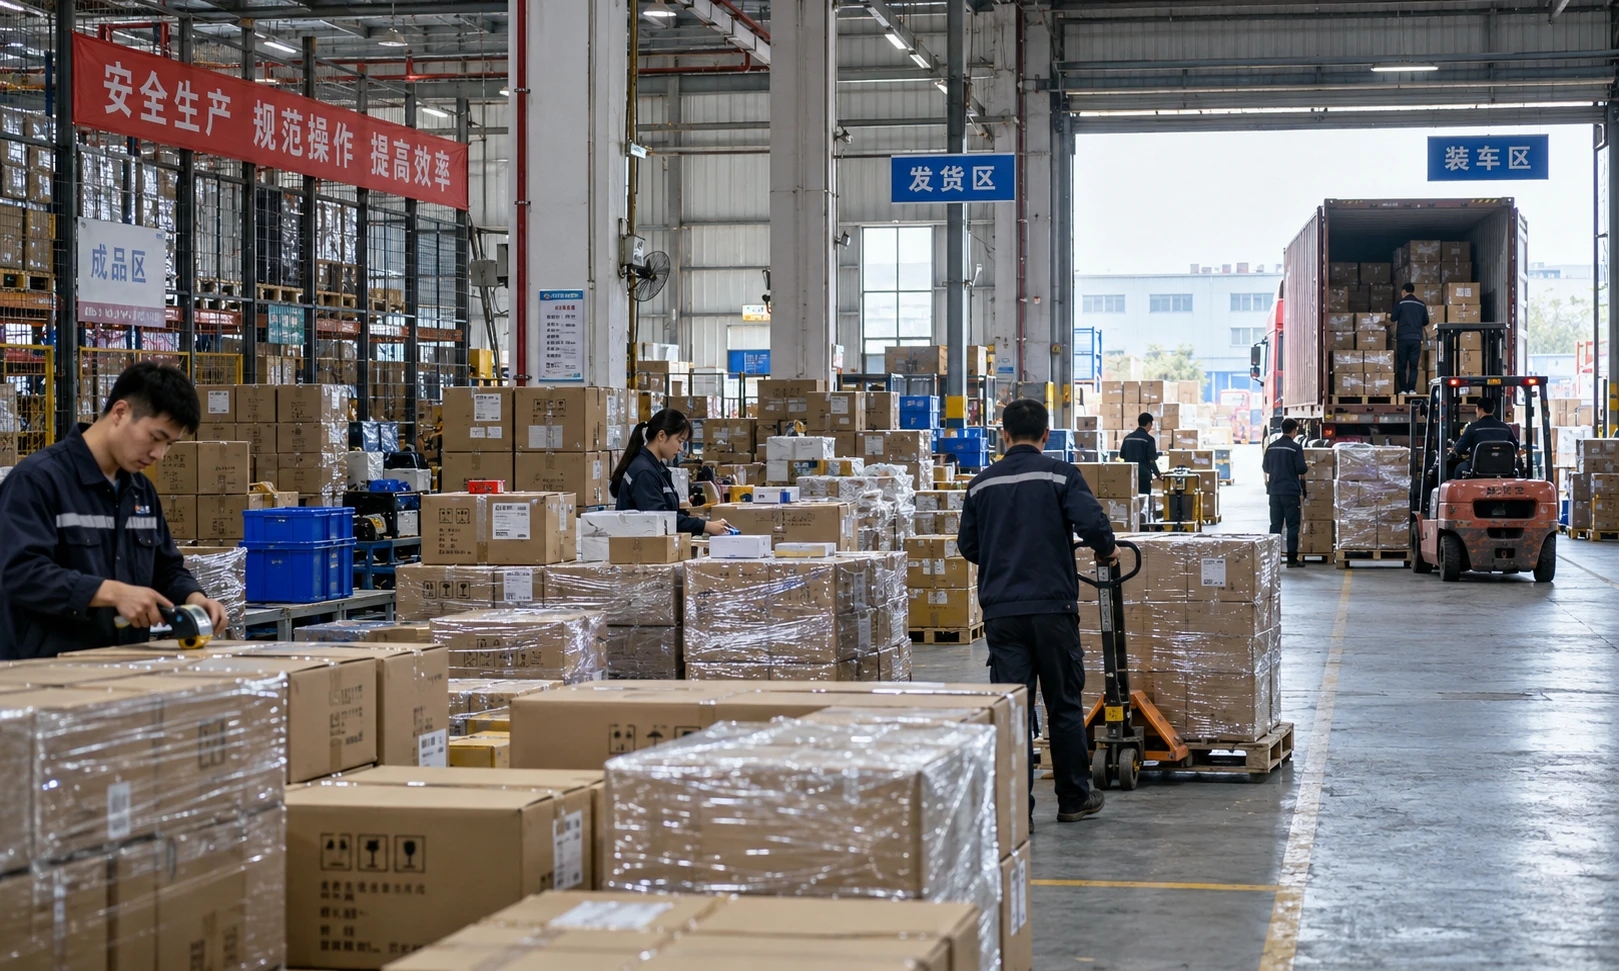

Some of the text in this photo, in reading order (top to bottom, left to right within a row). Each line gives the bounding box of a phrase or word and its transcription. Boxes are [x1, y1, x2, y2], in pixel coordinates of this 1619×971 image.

[104, 61, 451, 192] 安全生产 规范操作 提高效率
[1444, 145, 1531, 171] 装车区
[908, 166, 996, 192] 发货区
[90, 243, 147, 283] 成品区
